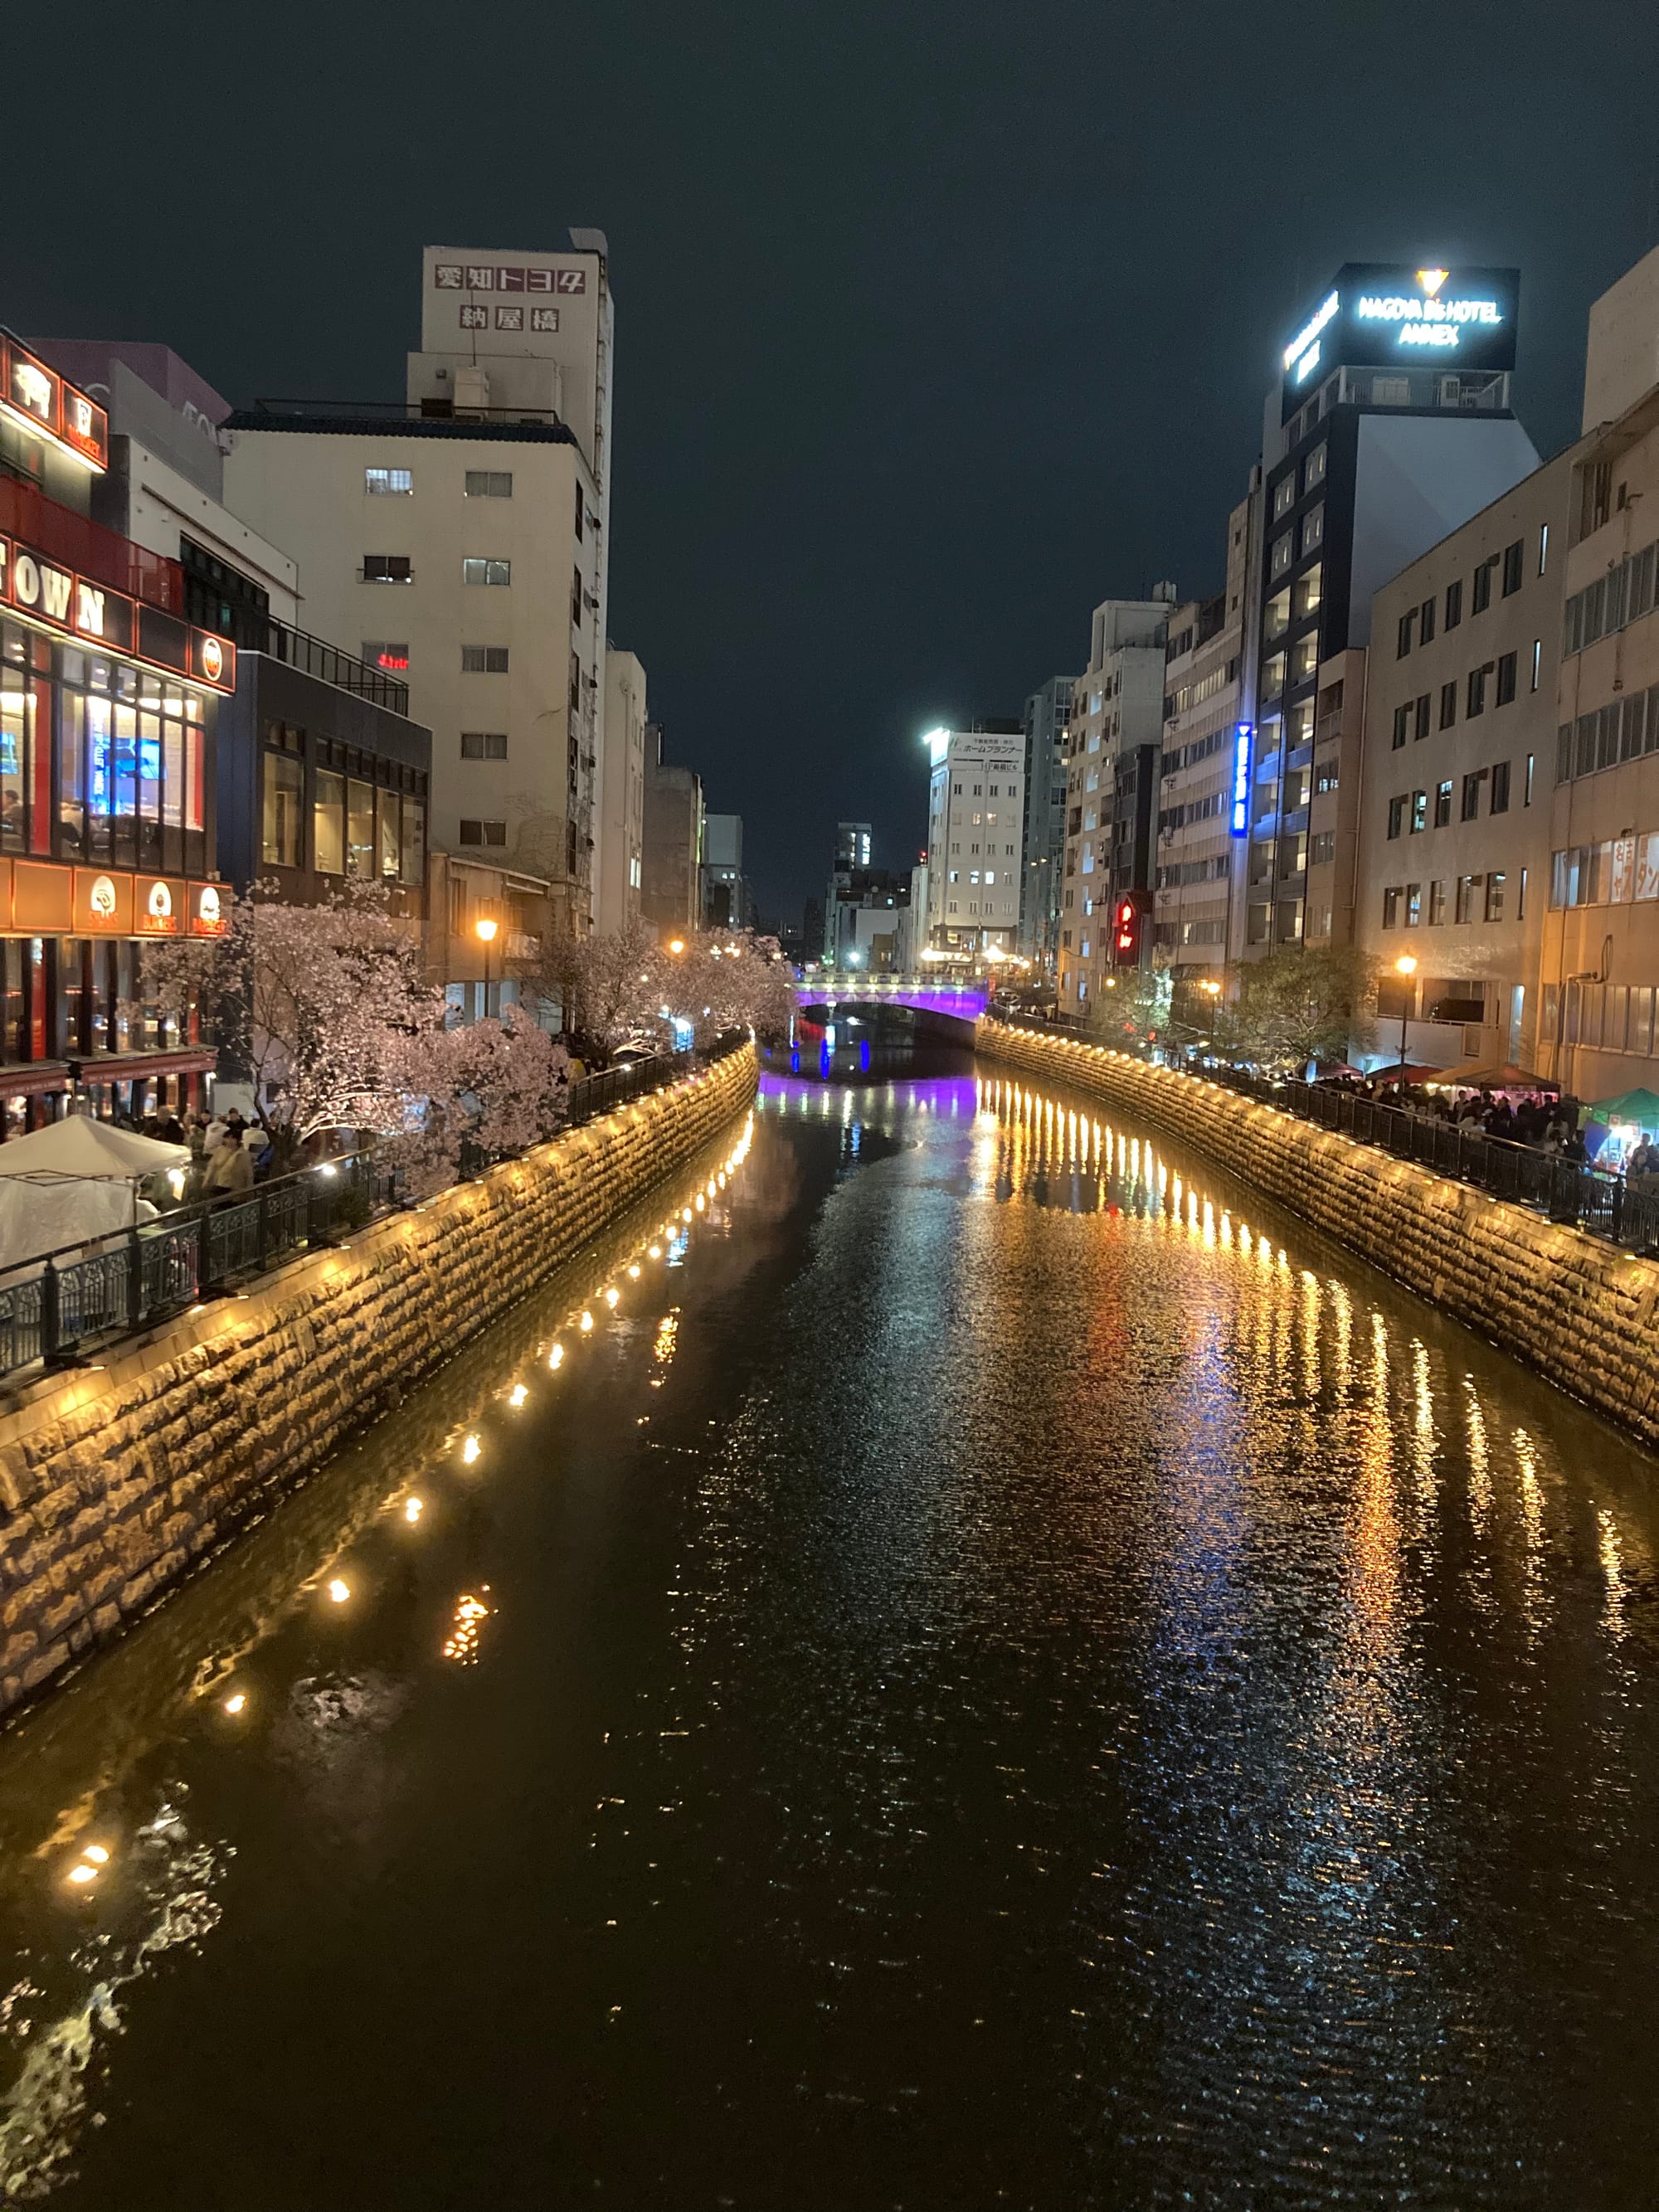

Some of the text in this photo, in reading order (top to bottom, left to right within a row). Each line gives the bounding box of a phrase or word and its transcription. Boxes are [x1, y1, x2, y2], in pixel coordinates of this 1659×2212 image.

[436, 265, 585, 293] 愛知トヨタ
[461, 306, 559, 332] 納屋橋
[1358, 297, 1423, 320] NAGOYA
[1446, 300, 1503, 323] HOTEL
[1399, 323, 1460, 346] ANNEX
